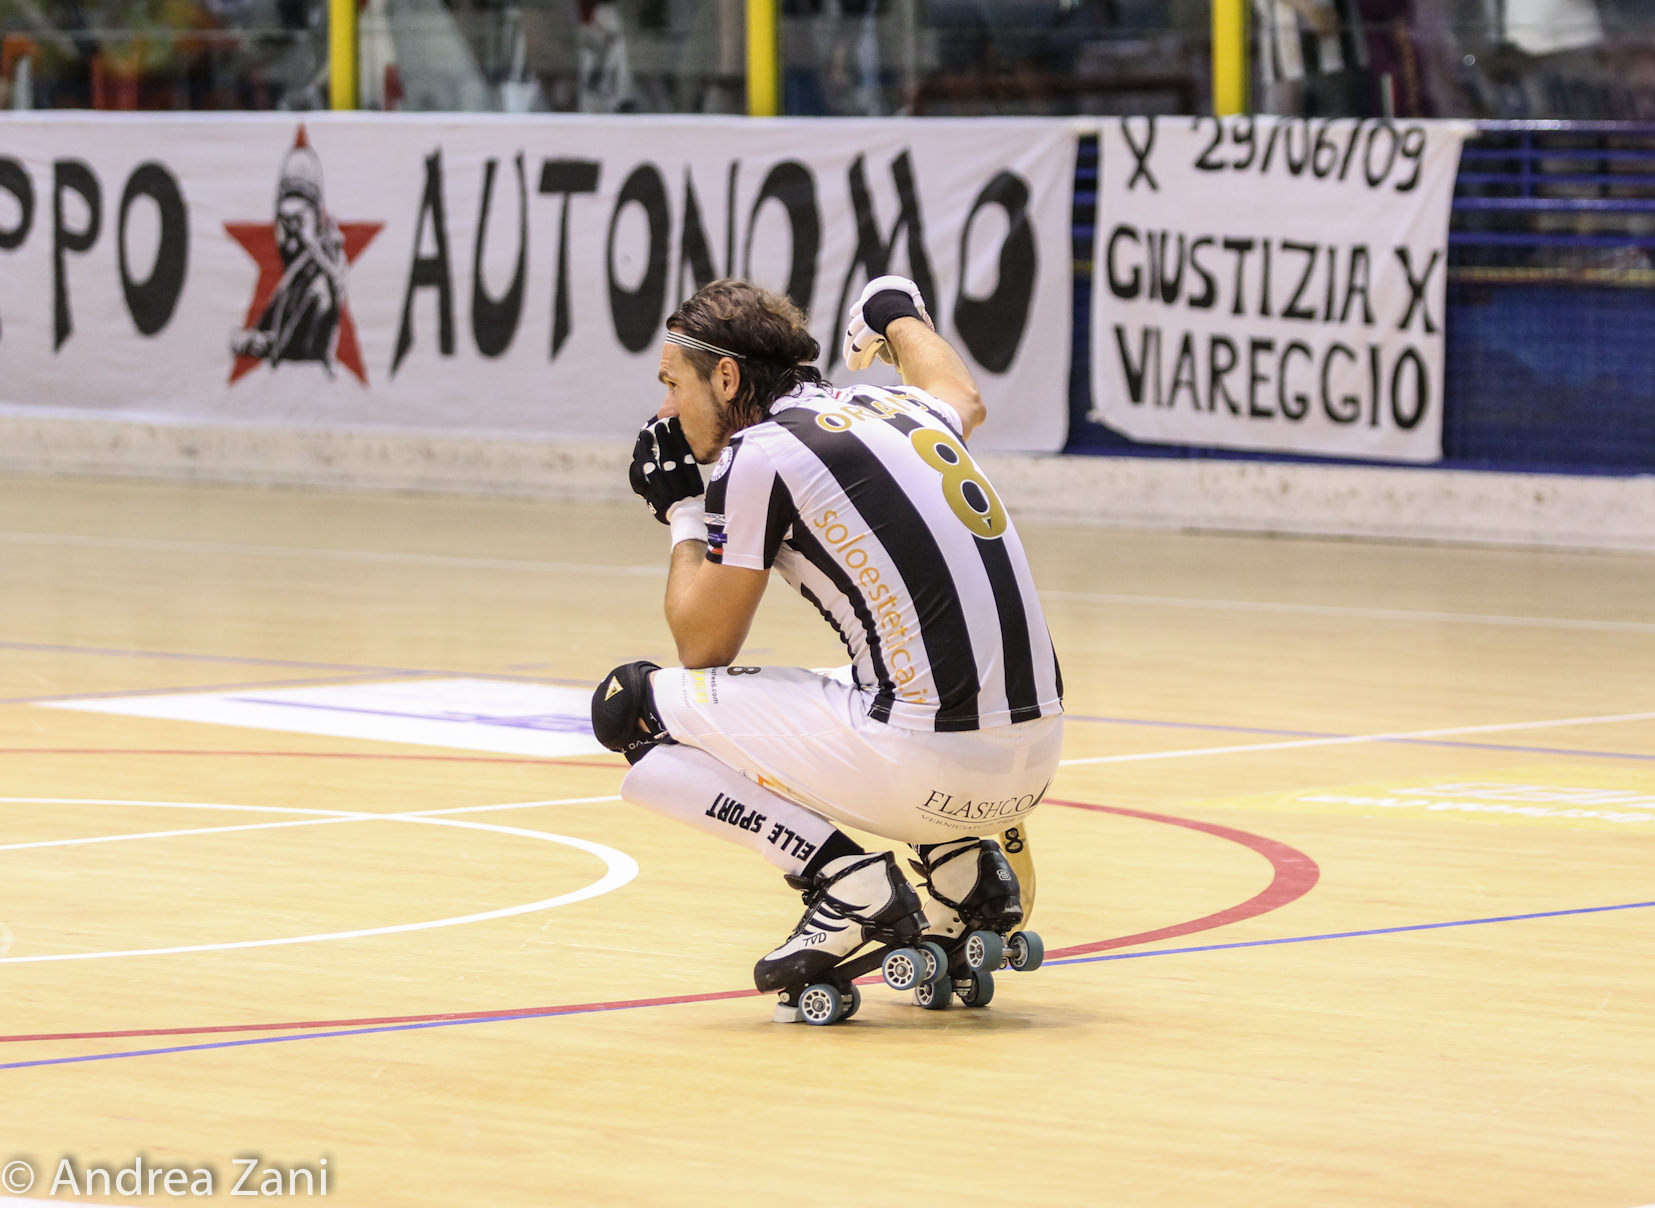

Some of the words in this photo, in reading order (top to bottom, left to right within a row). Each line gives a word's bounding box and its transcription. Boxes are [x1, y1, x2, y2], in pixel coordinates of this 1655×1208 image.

[390, 145, 1038, 381] AUTONOMO
[1106, 224, 1376, 326] GIUSTIZIA
[1394, 246, 1440, 333] X
[1113, 323, 1431, 431] VIAREGGIO
[908, 428, 1008, 540] 8
[813, 510, 929, 704] soloestetica.it
[705, 792, 767, 833] SPORT
[767, 822, 817, 862] ELLE
[802, 932, 827, 947] TVD
